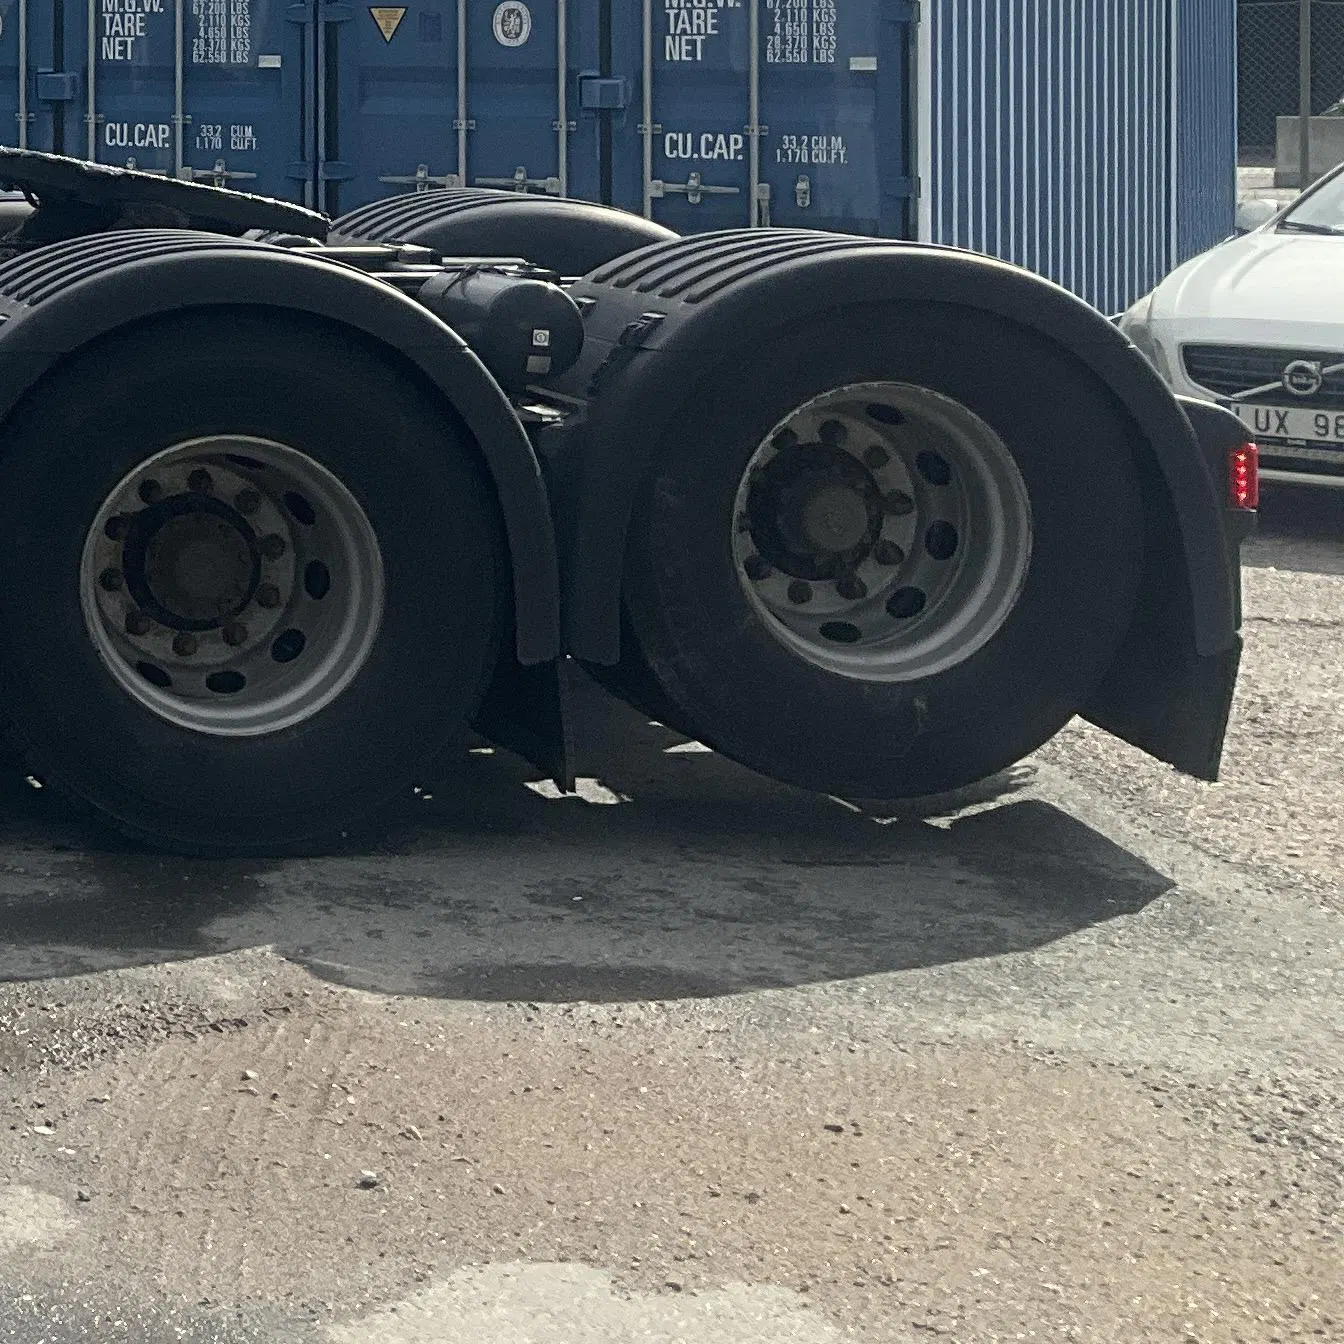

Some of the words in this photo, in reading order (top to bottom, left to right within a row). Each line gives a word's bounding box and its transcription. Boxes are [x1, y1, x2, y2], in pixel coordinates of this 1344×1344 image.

[230, 2, 249, 14] LBS
[230, 15, 251, 26] KGS
[665, 9, 719, 34] TARE
[813, 9, 837, 22] KGS
[102, 13, 146, 36] TARE
[813, 22, 835, 36] LBS
[230, 27, 249, 39] LBS
[102, 37, 135, 60] NET
[230, 39, 251, 51] KGS
[665, 35, 706, 61] NET
[813, 36, 837, 50] KGS
[230, 51, 249, 63] LBS
[813, 50, 835, 64] LBS
[105, 122, 170, 148] CU.CAP.
[664, 132, 743, 160] CU.CAP.
[782, 135, 808, 150] 33.2
